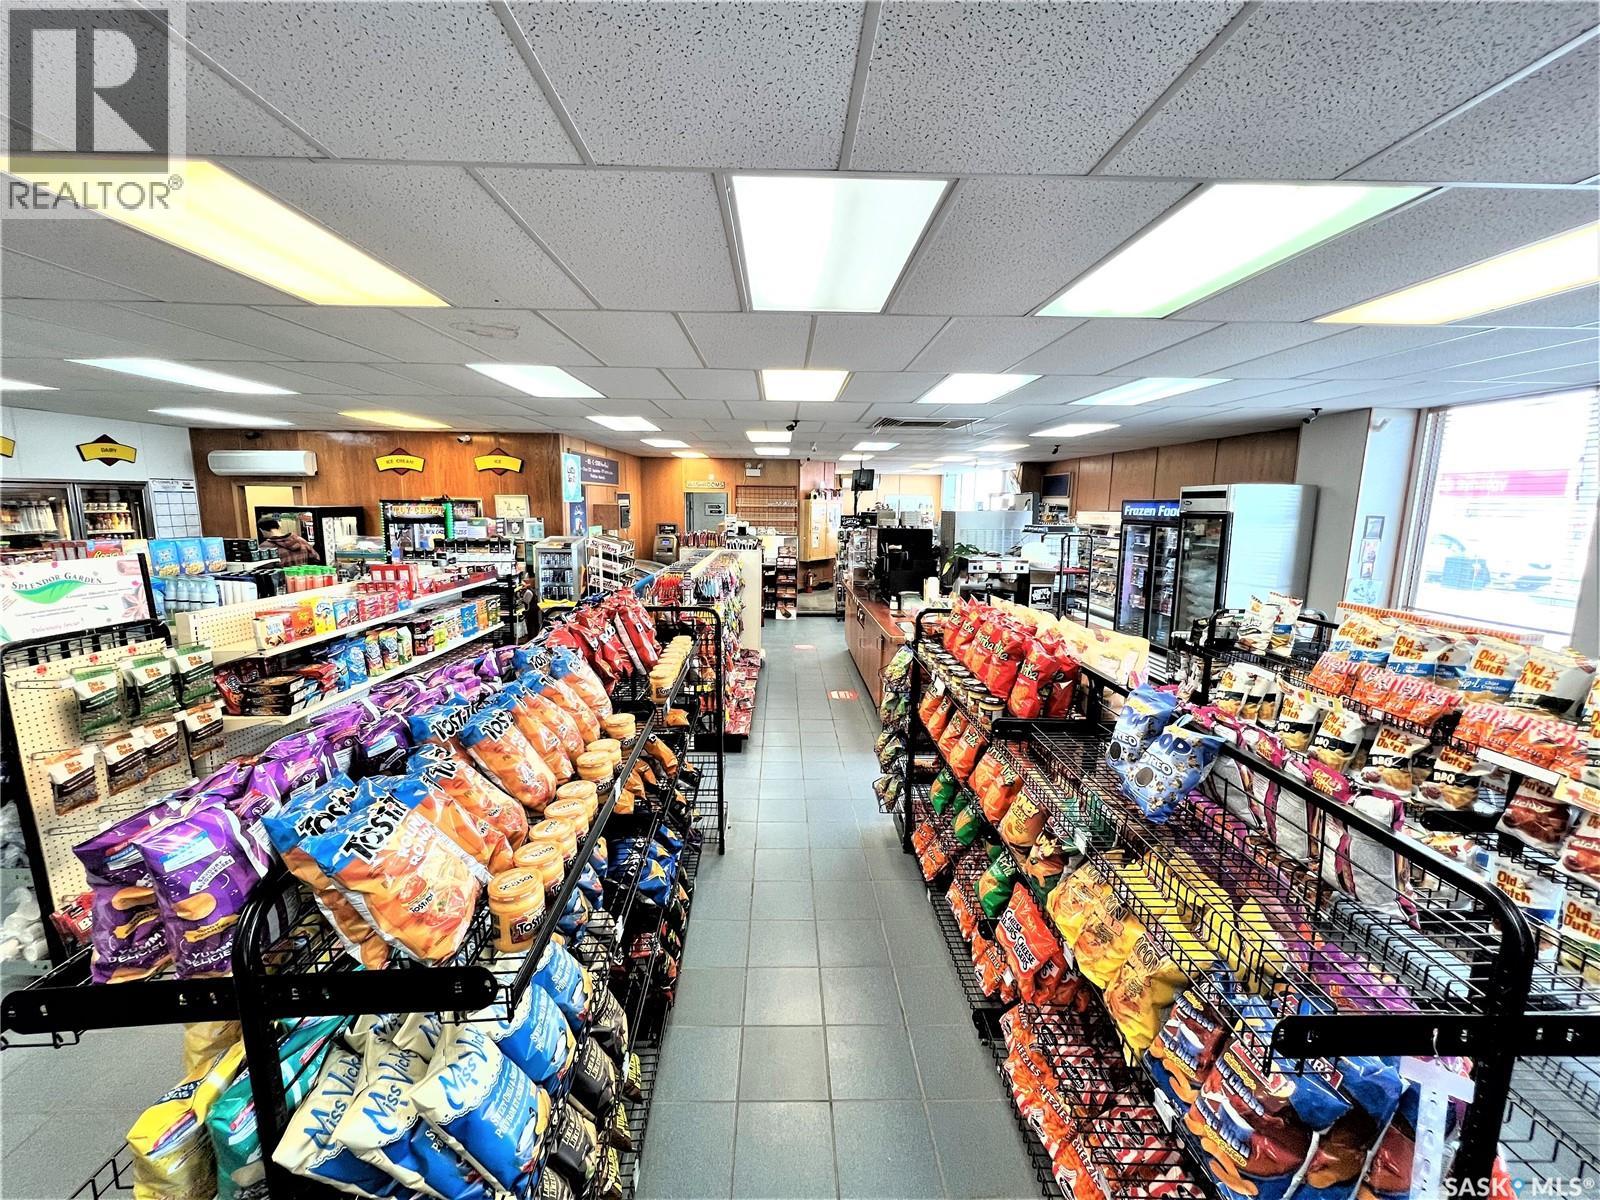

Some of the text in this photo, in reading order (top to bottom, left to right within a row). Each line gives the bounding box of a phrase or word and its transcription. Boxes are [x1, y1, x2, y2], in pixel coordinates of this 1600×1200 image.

[1124, 505, 1156, 516] Frozen
[11, 571, 102, 590] SPLENDOR GARDEN
[1397, 636, 1415, 649] Old
[1478, 649, 1496, 662] Old
[1473, 659, 1505, 676] Dutch
[1327, 711, 1341, 724] Old
[1322, 719, 1342, 738] Dutch
[1380, 728, 1400, 742] Old
[1376, 737, 1407, 755] Dutch
[1372, 755, 1394, 767] BBQ
[1433, 771, 1456, 784] BBQ
[1497, 870, 1518, 887] Old
[1566, 902, 1593, 922] Old
[1015, 1042, 1042, 1078] HEEZIES
[438, 1057, 479, 1111] Miss
[362, 1084, 409, 1135] Miss
[1039, 1084, 1071, 1126] HEEZIES
[303, 1099, 348, 1151] Miss
